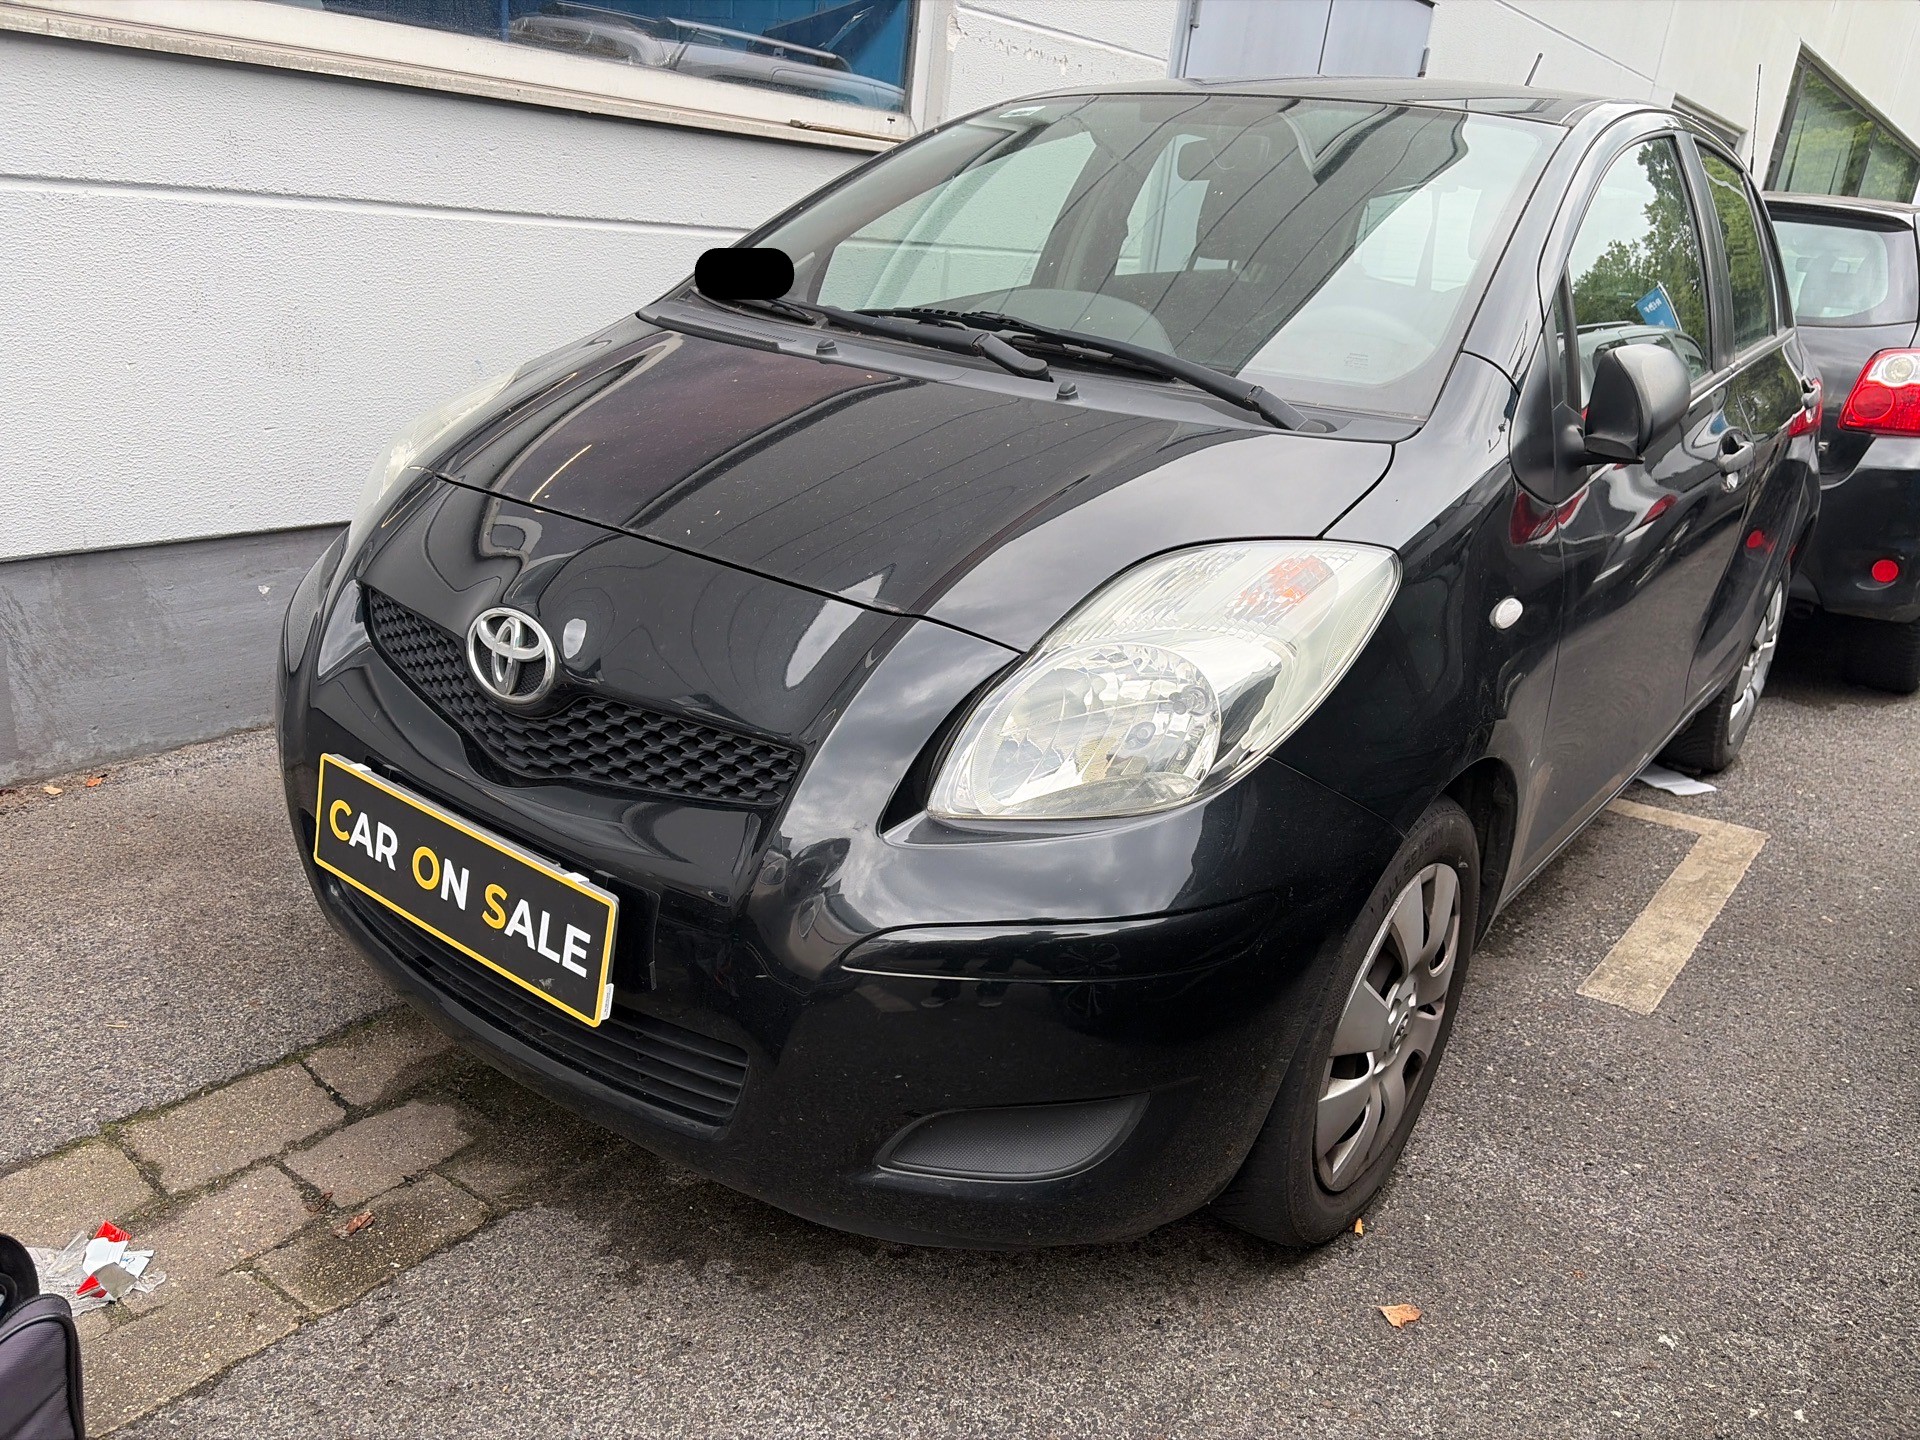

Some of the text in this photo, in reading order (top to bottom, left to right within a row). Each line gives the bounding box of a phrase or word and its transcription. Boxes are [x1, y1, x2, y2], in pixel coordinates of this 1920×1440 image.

[329, 799, 591, 978] CAR ON SALE
[1382, 825, 1444, 911] ALL SEASON
